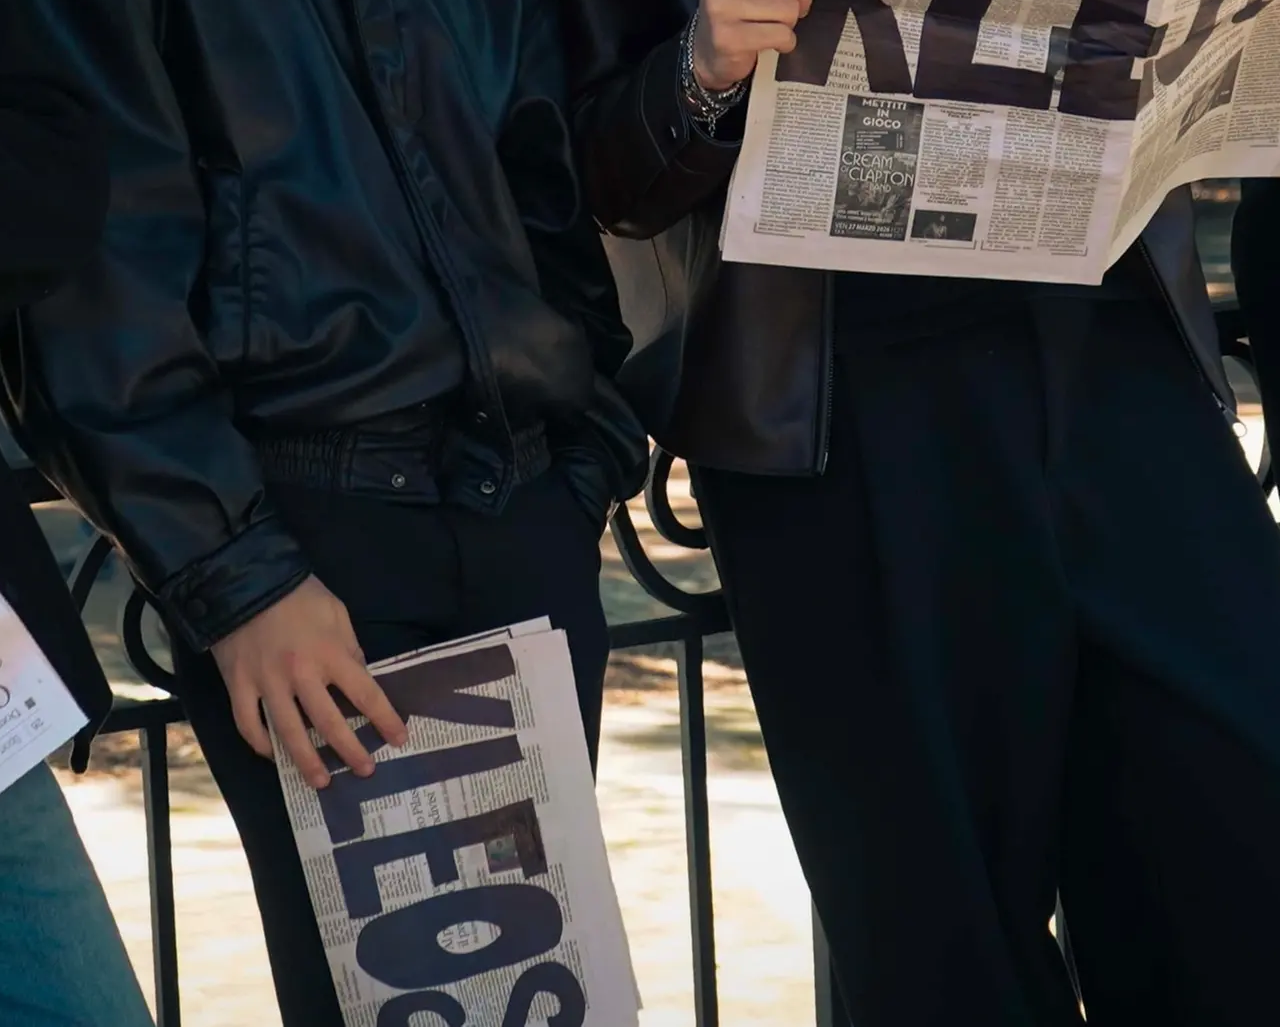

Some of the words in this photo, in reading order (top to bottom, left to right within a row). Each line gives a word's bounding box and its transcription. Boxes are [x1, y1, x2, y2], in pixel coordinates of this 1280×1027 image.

[828, 81, 850, 90] ream
[862, 97, 907, 111] METTITI
[876, 108, 890, 118] IN
[862, 116, 902, 130] GIOCO
[841, 151, 893, 170] CREAM
[848, 166, 915, 188] CLAPTON
[856, 224, 876, 232] MARZO
[303, 643, 586, 1027] KLEOS
